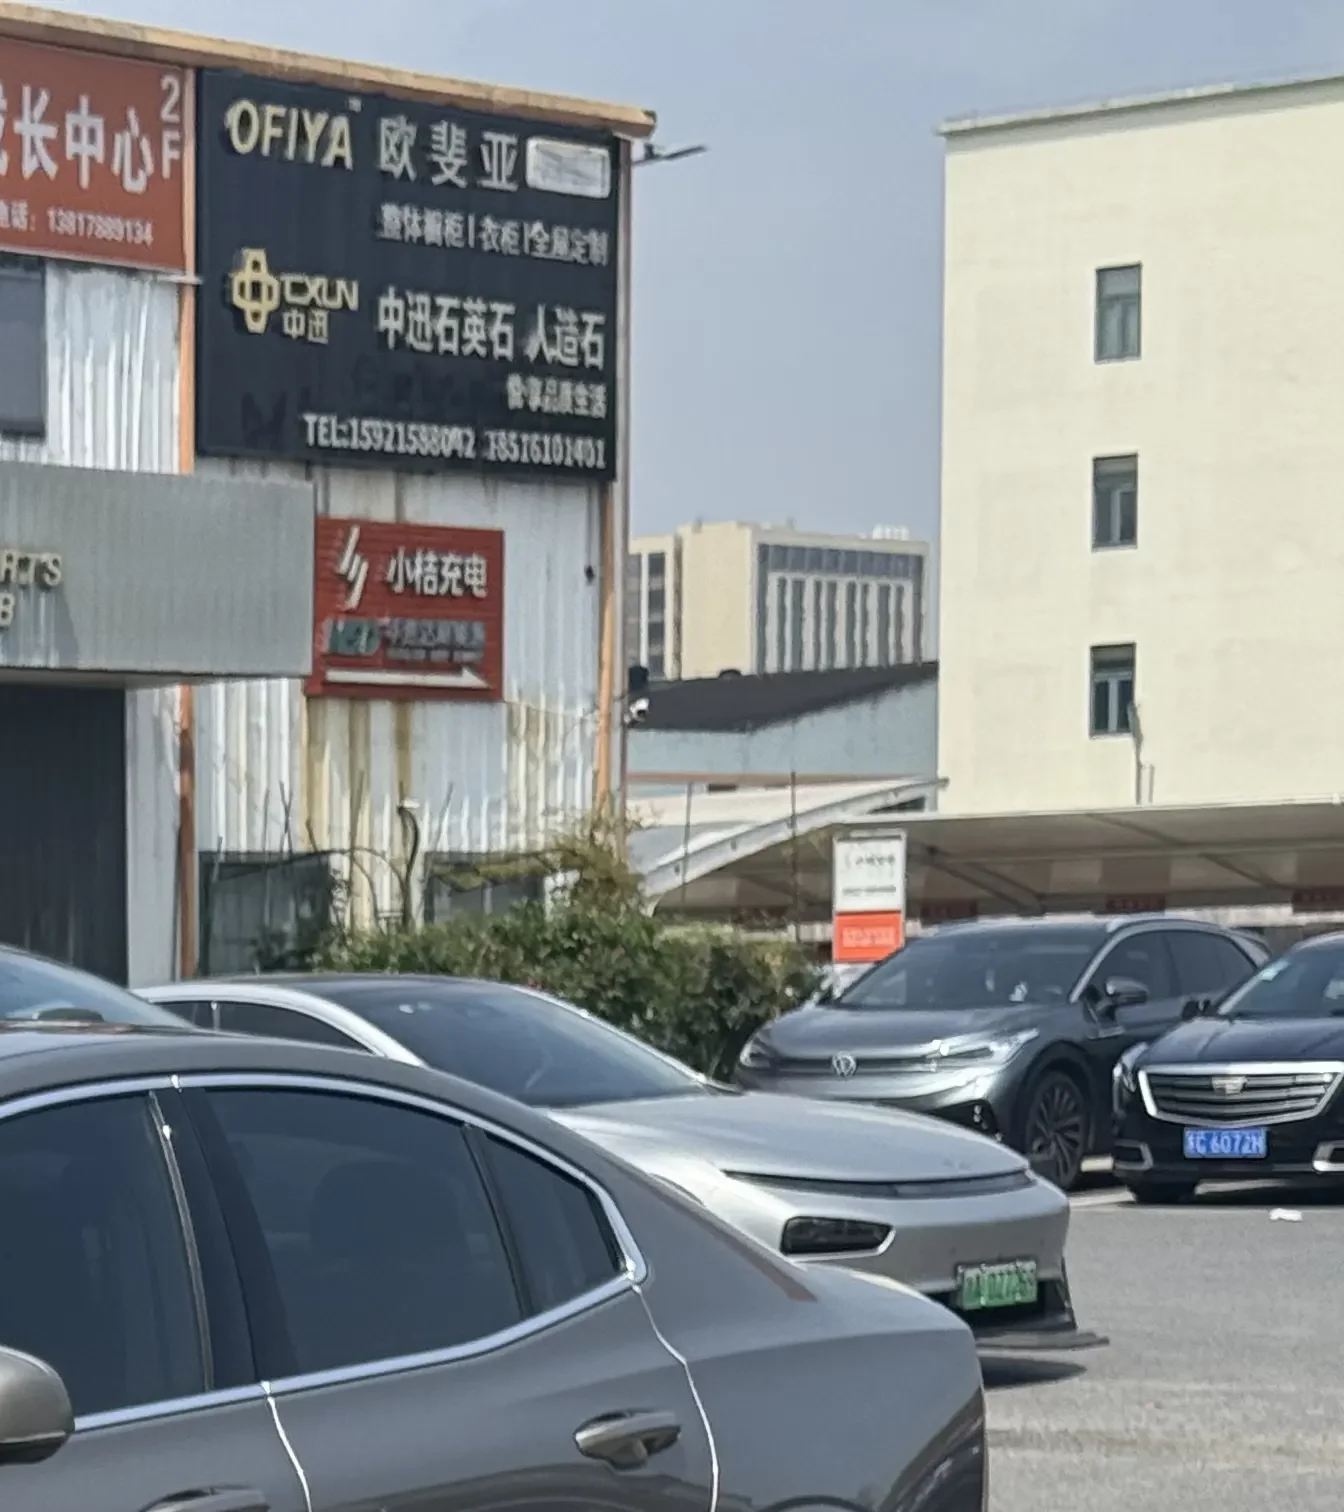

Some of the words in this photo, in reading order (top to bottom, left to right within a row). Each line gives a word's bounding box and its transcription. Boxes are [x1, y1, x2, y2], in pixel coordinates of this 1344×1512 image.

[225, 98, 354, 171] OFIYA
[378, 114, 520, 192] 欧斐亚
[378, 286, 516, 362] 中迅石英石
[526, 304, 606, 371] 人造石
[385, 545, 489, 598] 小桔充电
